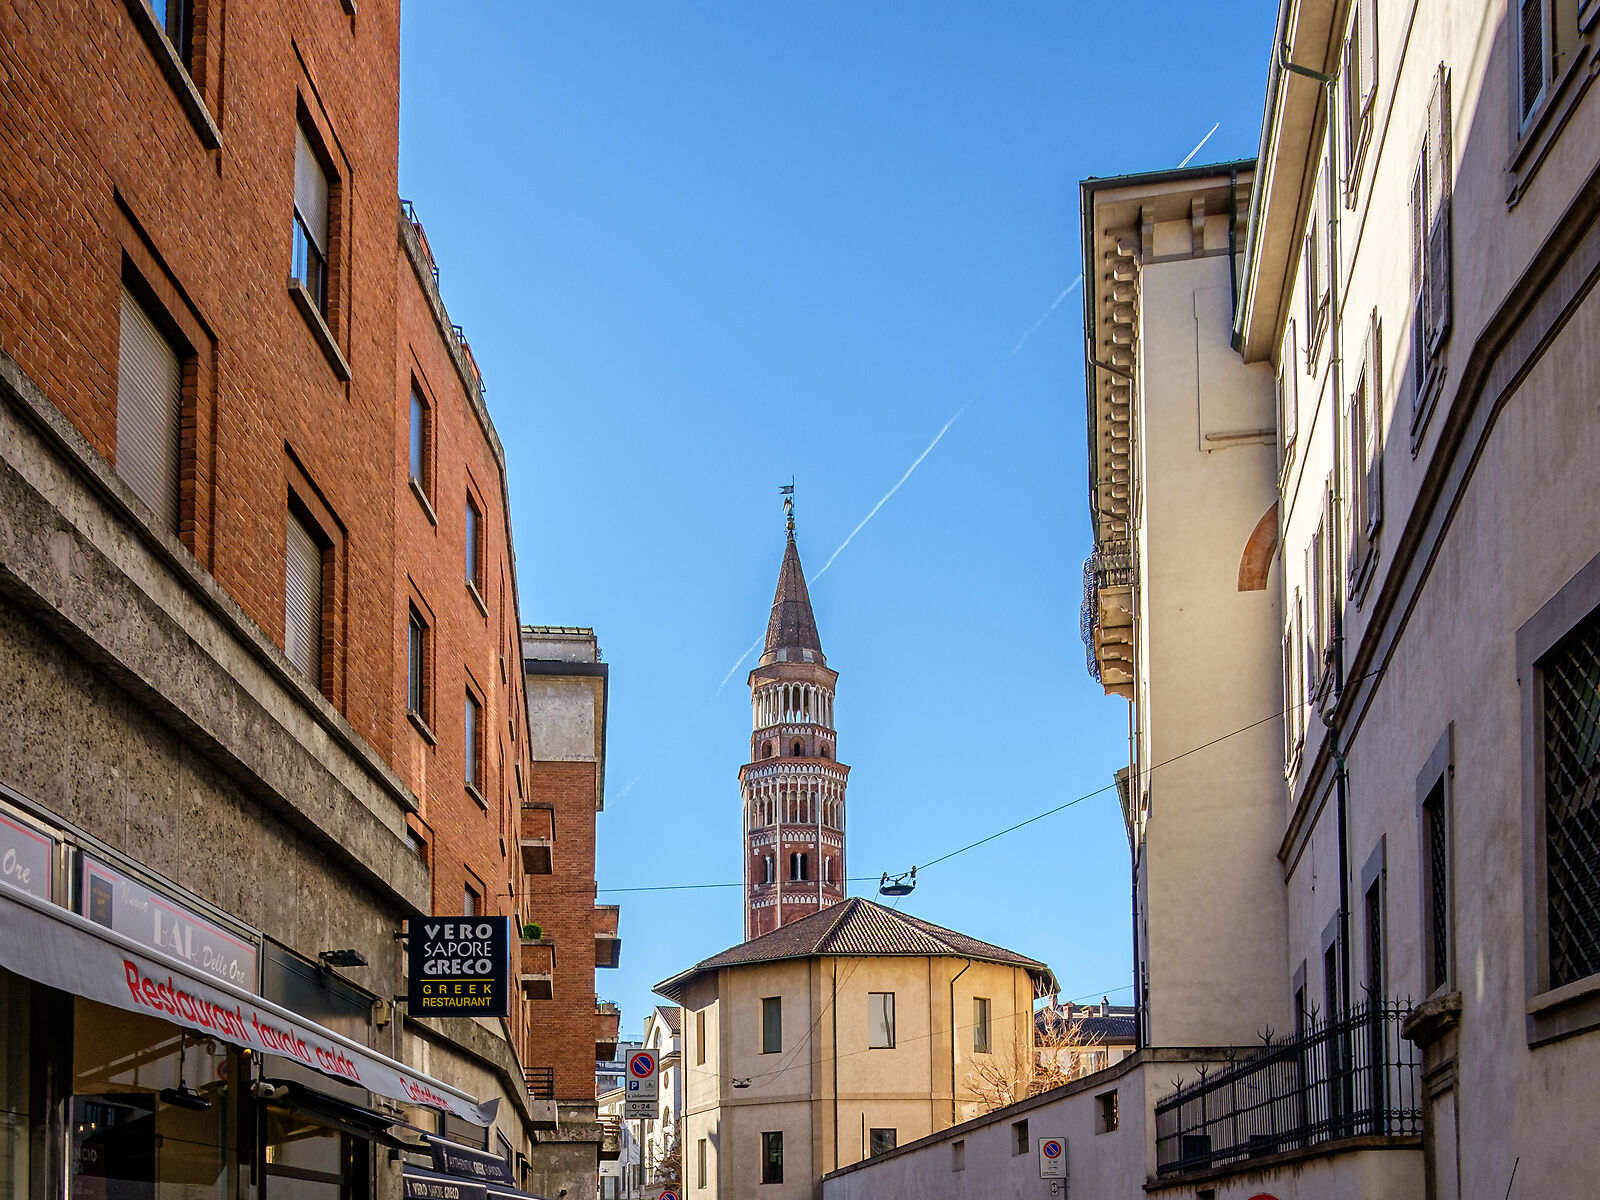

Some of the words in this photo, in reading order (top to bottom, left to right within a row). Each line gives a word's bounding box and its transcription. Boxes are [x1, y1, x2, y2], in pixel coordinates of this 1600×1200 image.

[3, 848, 31, 884] Ore
[424, 924, 493, 940] VERO
[153, 908, 198, 962] BAR
[202, 945, 228, 977] Delle
[229, 959, 247, 985] Ore
[424, 941, 492, 957] SAPORE
[423, 958, 493, 975] GRECO
[423, 984, 492, 995] GREEK
[423, 997, 492, 1007] RESTAURANT
[122, 959, 250, 1042] Restaurant
[252, 1012, 309, 1063] tavola
[315, 1047, 361, 1081] calda
[412, 1182, 428, 1197] VERO
[444, 1186, 459, 1200] GRECO
